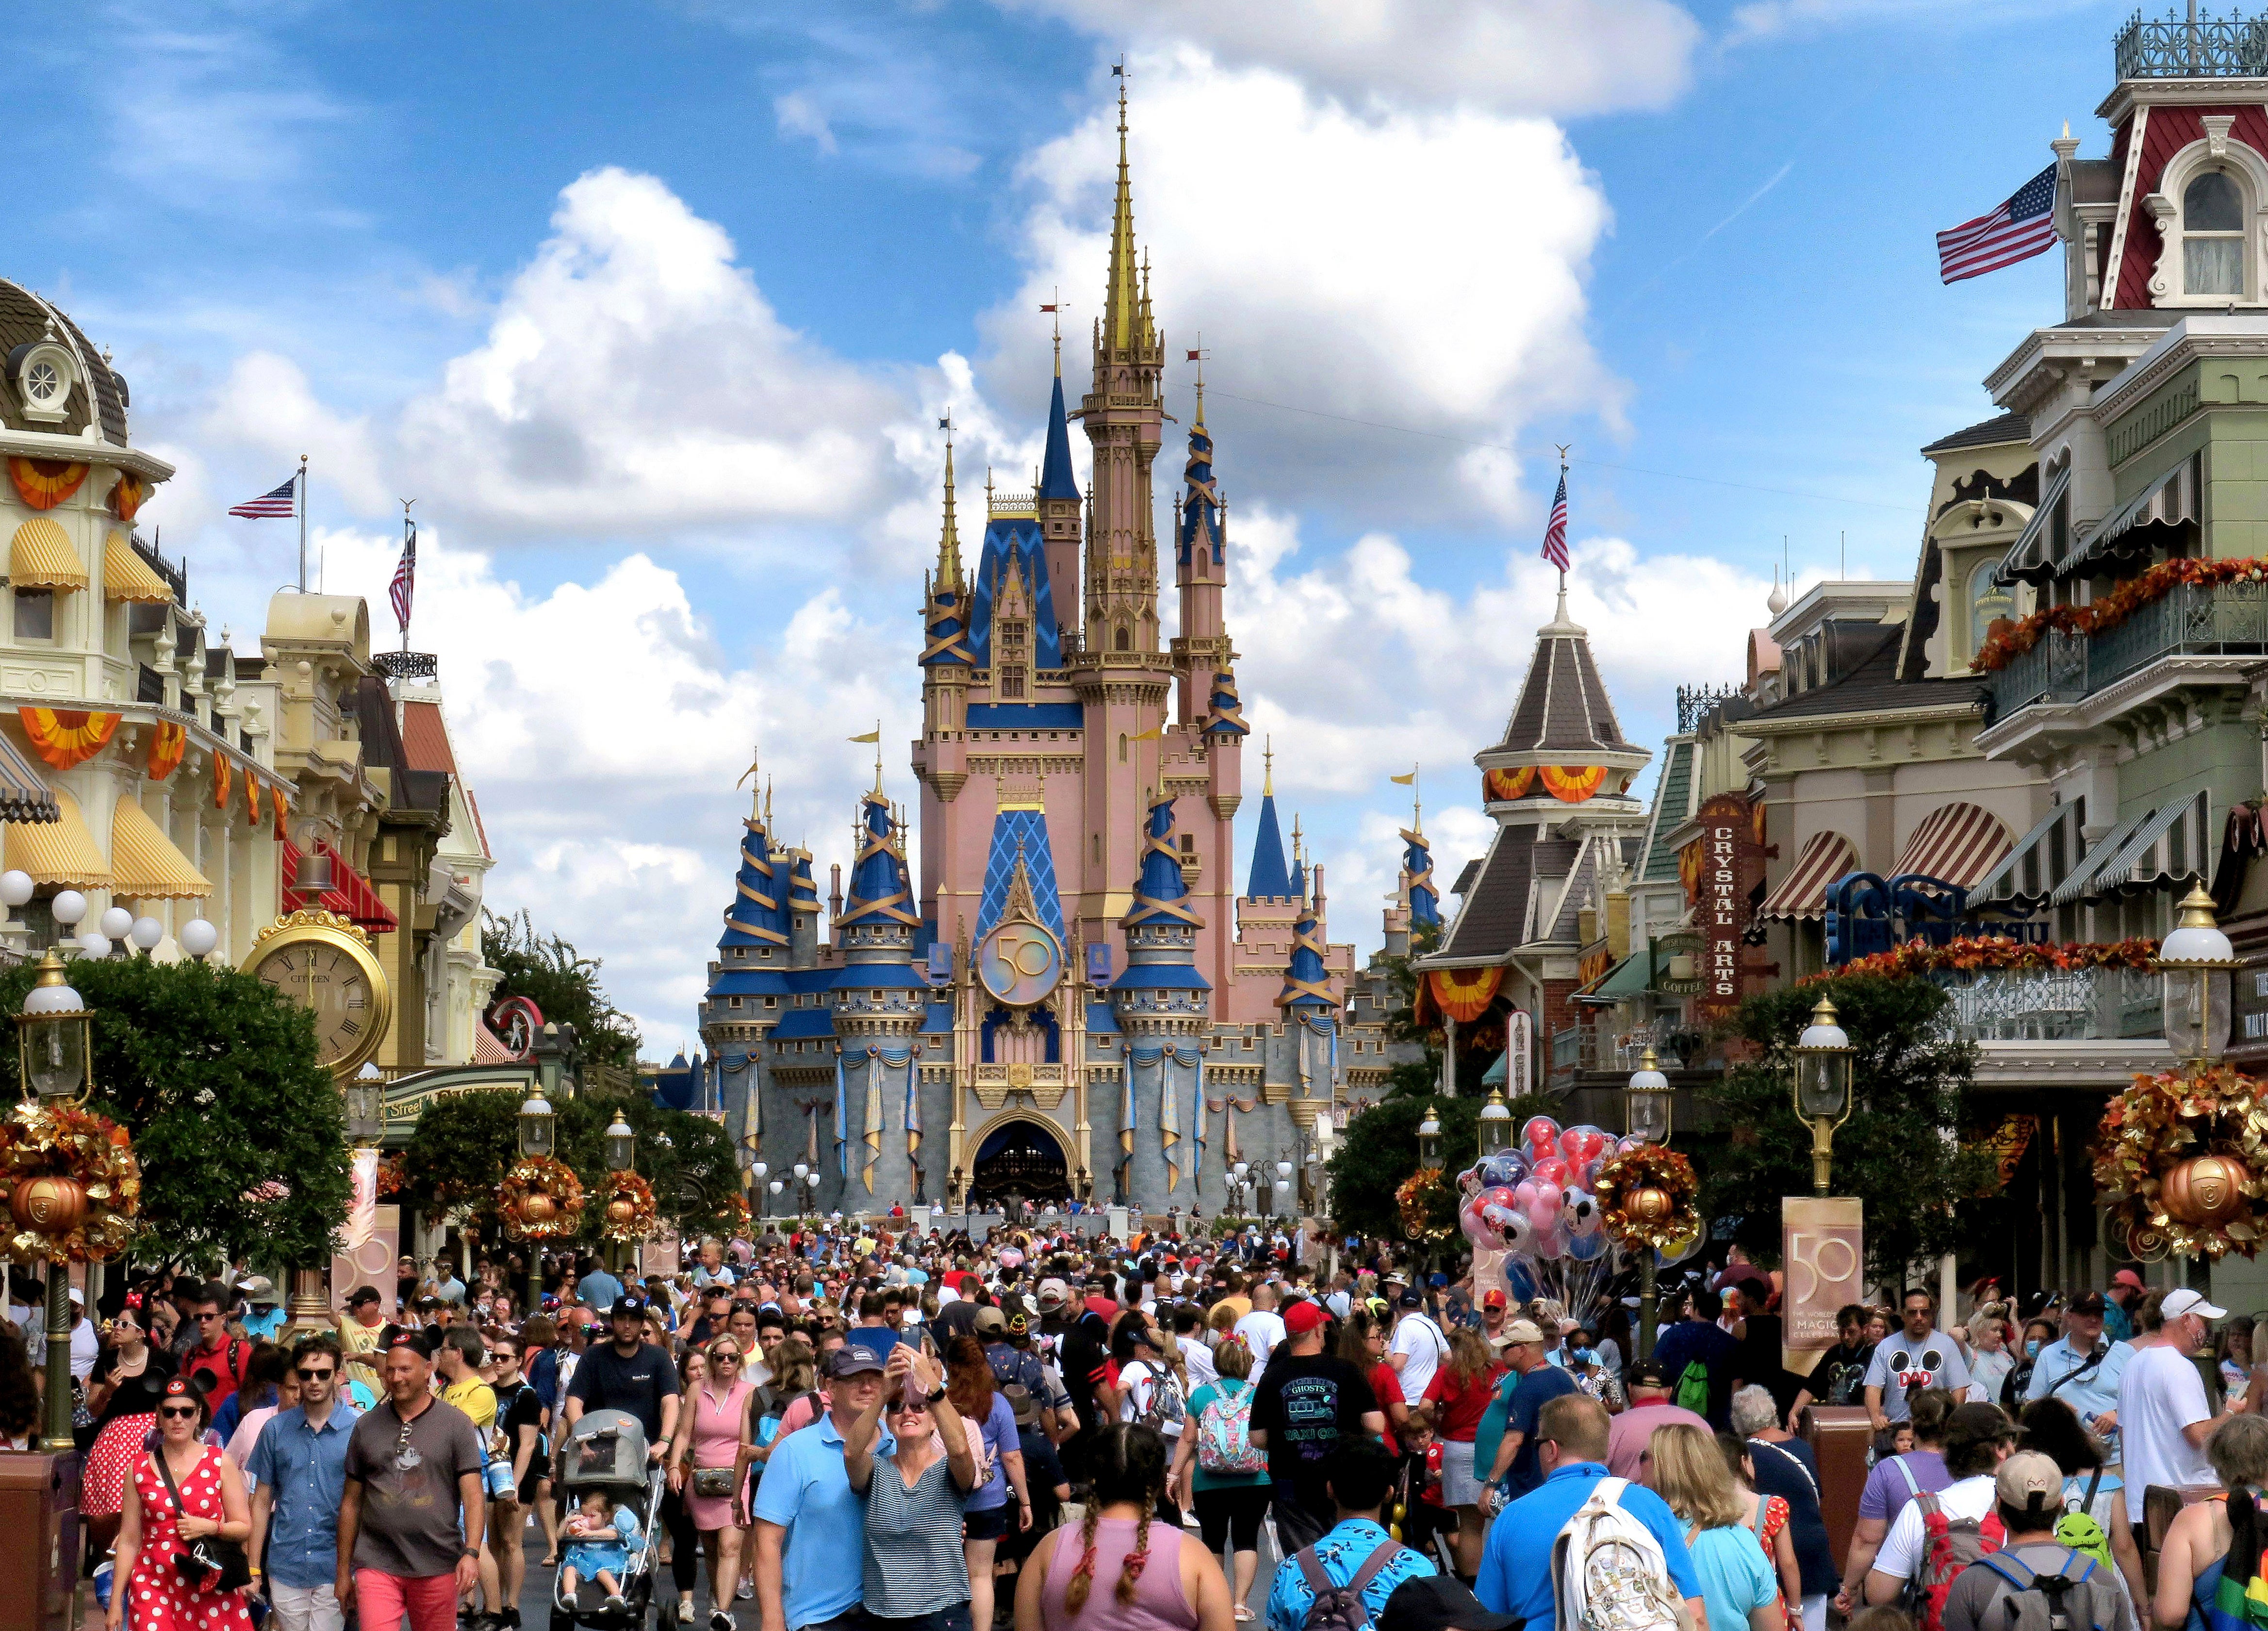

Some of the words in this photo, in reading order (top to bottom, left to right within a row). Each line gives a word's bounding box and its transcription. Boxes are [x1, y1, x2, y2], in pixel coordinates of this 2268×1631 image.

[1713, 827, 1734, 925] CRYSTAL
[997, 936, 1052, 995] 50
[1714, 939, 1735, 995] ARTS
[290, 974, 330, 983] CITZEN
[1663, 979, 1704, 994] COFFEE
[390, 1097, 423, 1117] Street
[1792, 1233, 1857, 1304] 50
[1797, 1320, 1839, 1330] MAGIC
[1898, 1370, 1933, 1388] DAD
[1291, 1385, 1326, 1394] GHOSTS
[1284, 1428, 1316, 1441] TAXI
